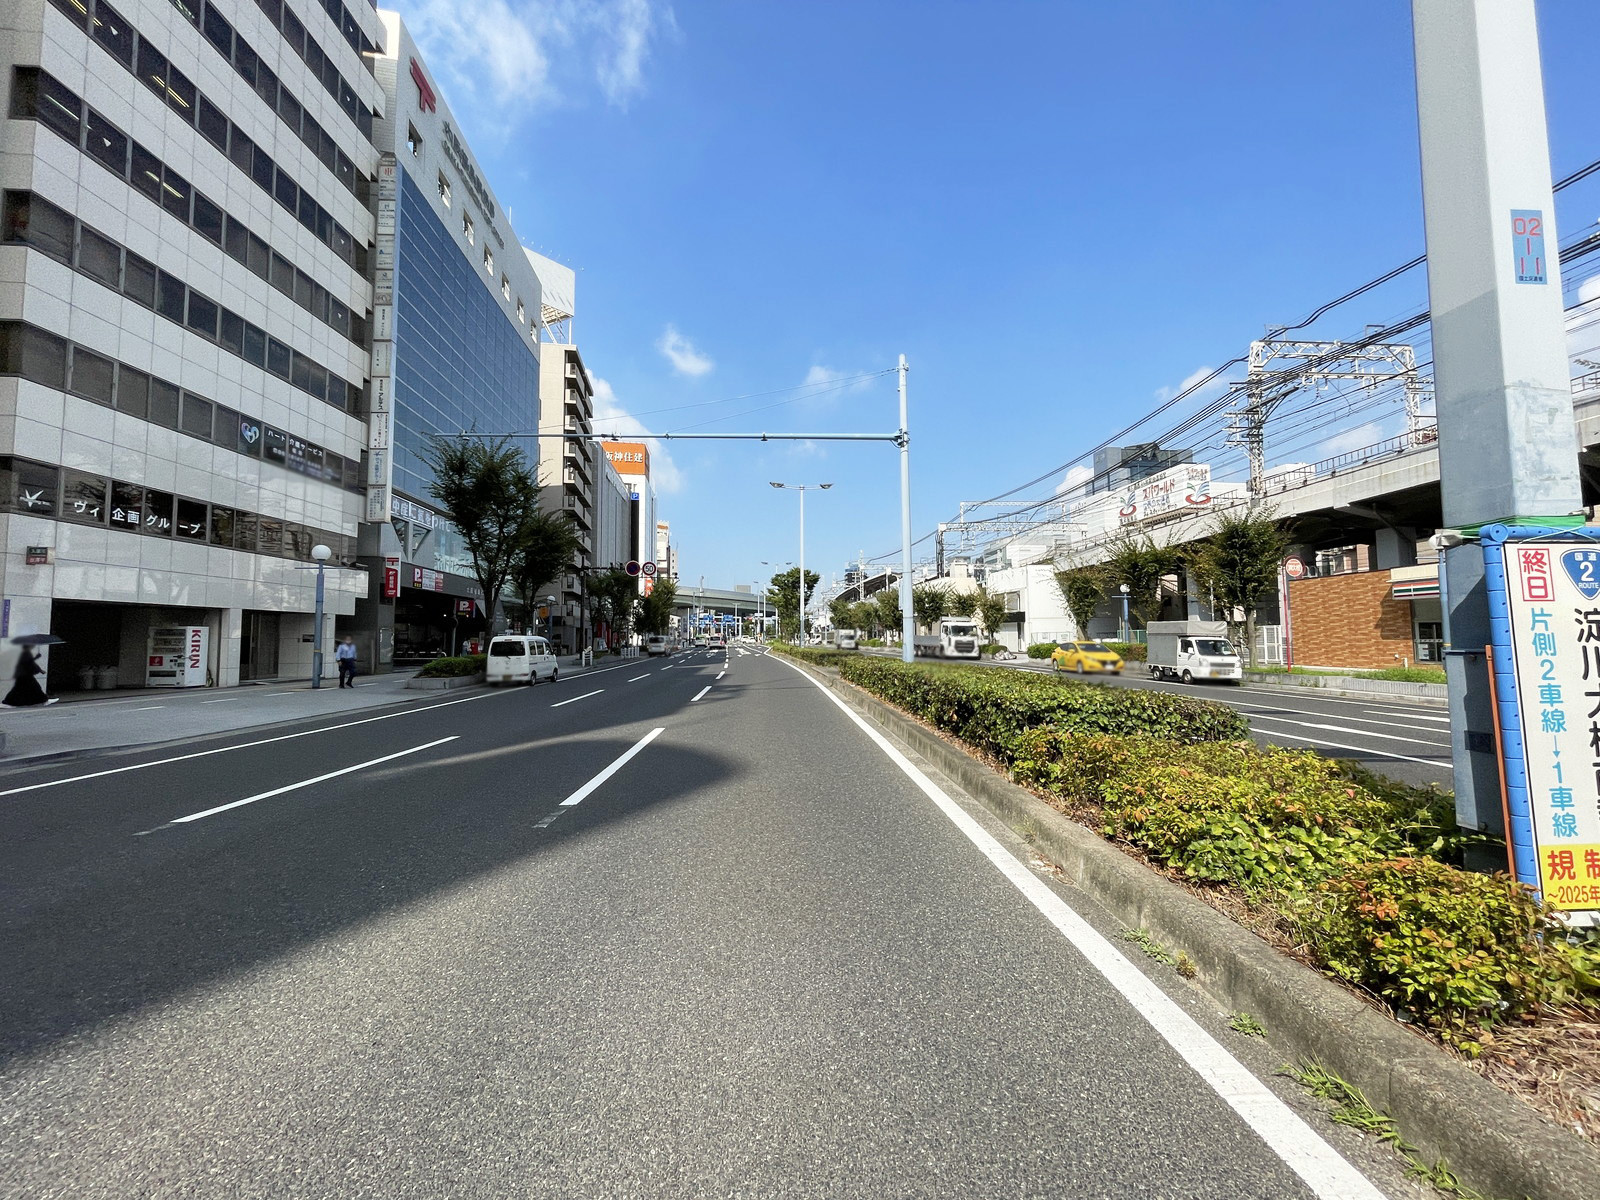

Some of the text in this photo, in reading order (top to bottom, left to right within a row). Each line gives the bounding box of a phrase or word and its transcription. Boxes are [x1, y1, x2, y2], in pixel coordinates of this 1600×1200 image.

[1513, 217, 1541, 236] 02
[606, 451, 643, 463] 阪神住建
[1574, 552, 1597, 561] 国道
[645, 565, 654, 573] 50
[1522, 550, 1549, 599] 終日
[1579, 561, 1595, 582] 2
[190, 630, 201, 669] KIRIN
